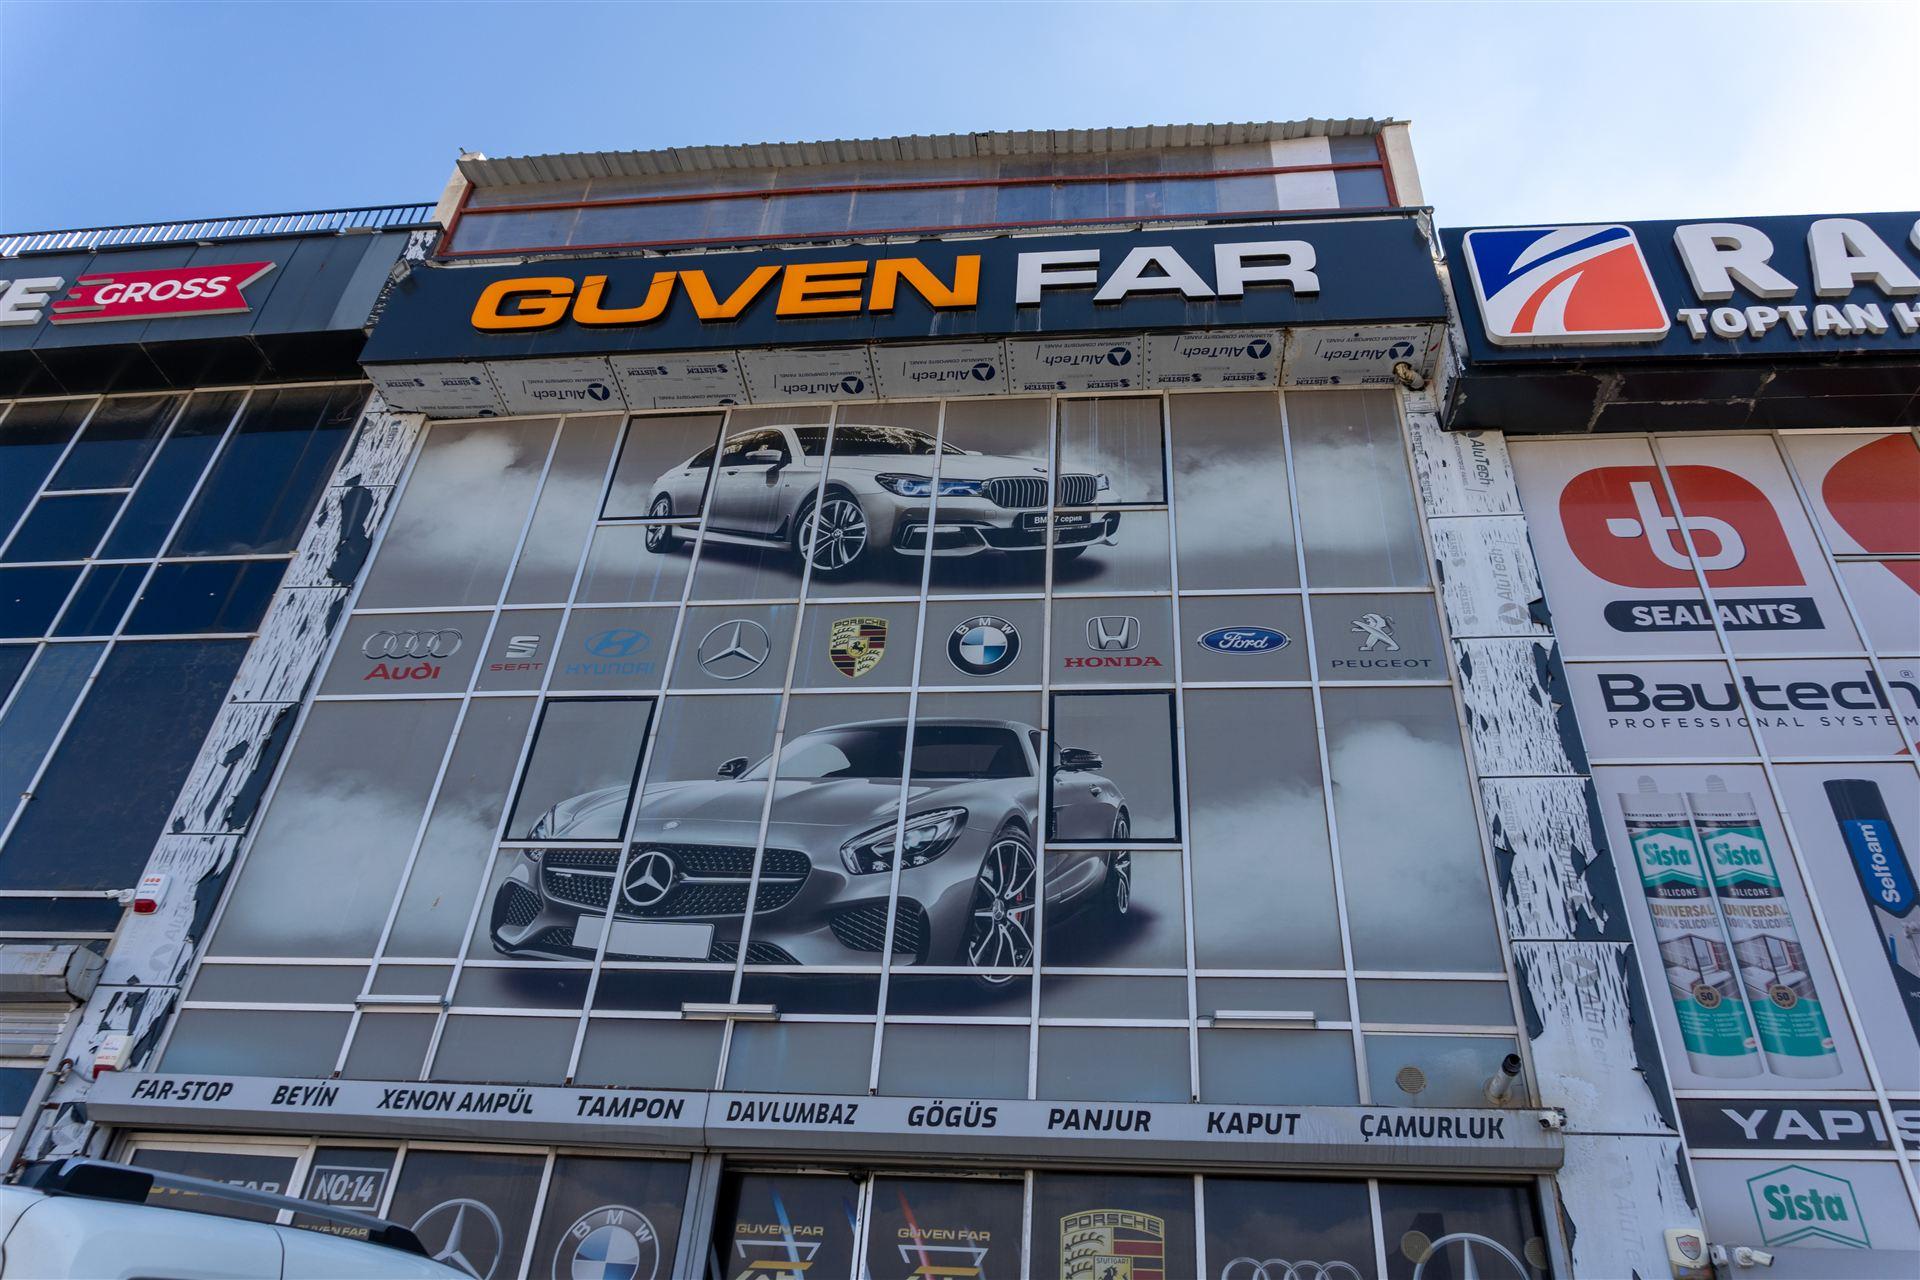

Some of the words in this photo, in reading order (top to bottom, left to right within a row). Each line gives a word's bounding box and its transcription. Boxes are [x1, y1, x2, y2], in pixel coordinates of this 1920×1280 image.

[1673, 218, 1920, 300] RA
[94, 276, 231, 305] GROSS
[471, 255, 982, 333] GUVEN
[1016, 240, 1321, 306] FAR
[0, 276, 65, 327] E
[1677, 303, 1889, 340] TOPTAN
[1045, 354, 1106, 366] AluTech
[1183, 346, 1247, 358] AluTech
[1324, 349, 1387, 362] AluTech
[912, 369, 970, 381] AluTech
[533, 389, 586, 400] AluTech
[783, 382, 839, 395] AluTech
[833, 618, 887, 628] PORSCHE
[956, 616, 1015, 635] BMW
[1631, 604, 1802, 627] SEALANTS
[1218, 630, 1269, 650] Ford
[363, 662, 441, 681] Audi
[490, 662, 544, 672] SEAT
[565, 662, 655, 675] HYUNDAI
[1063, 656, 1163, 668] HONDA
[1331, 659, 1433, 669] PEUGEOT
[1608, 717, 1805, 729] PROFESSIONAL
[1642, 843, 1692, 866] Sista
[1713, 842, 1763, 866] Sista
[1861, 824, 1902, 903] Selfoam
[1658, 887, 1698, 897] SILICONE
[1731, 887, 1771, 897] SILICONE
[1651, 904, 1716, 918] UNIVERSAL
[1723, 904, 1788, 918] UNIVERSAL
[1700, 992, 1713, 1001] 50
[1777, 992, 1790, 1001] 50
[131, 1079, 234, 1102] FAR-STOP
[271, 1081, 340, 1107] BEYİN
[376, 1089, 455, 1112] XENON
[456, 1088, 534, 1115] AMPÜL
[576, 1095, 685, 1120] TAMPON
[726, 1100, 859, 1126] DAVLUMBAZ
[907, 1100, 998, 1128] GÖGÜS
[1048, 1108, 1152, 1132] PANJUR
[1207, 1112, 1301, 1136] KAPUT
[1360, 1114, 1505, 1142] ÇAMURLUK
[313, 1173, 376, 1203] NO:14
[1763, 1184, 1849, 1222] Sista
[572, 1208, 653, 1244] BMW
[735, 1222, 791, 1236] GUVEN
[792, 1225, 825, 1237] FAR
[1063, 1213, 1161, 1234] PORSCHE
[897, 1228, 956, 1241] GUVEN
[957, 1230, 991, 1242] FAR
